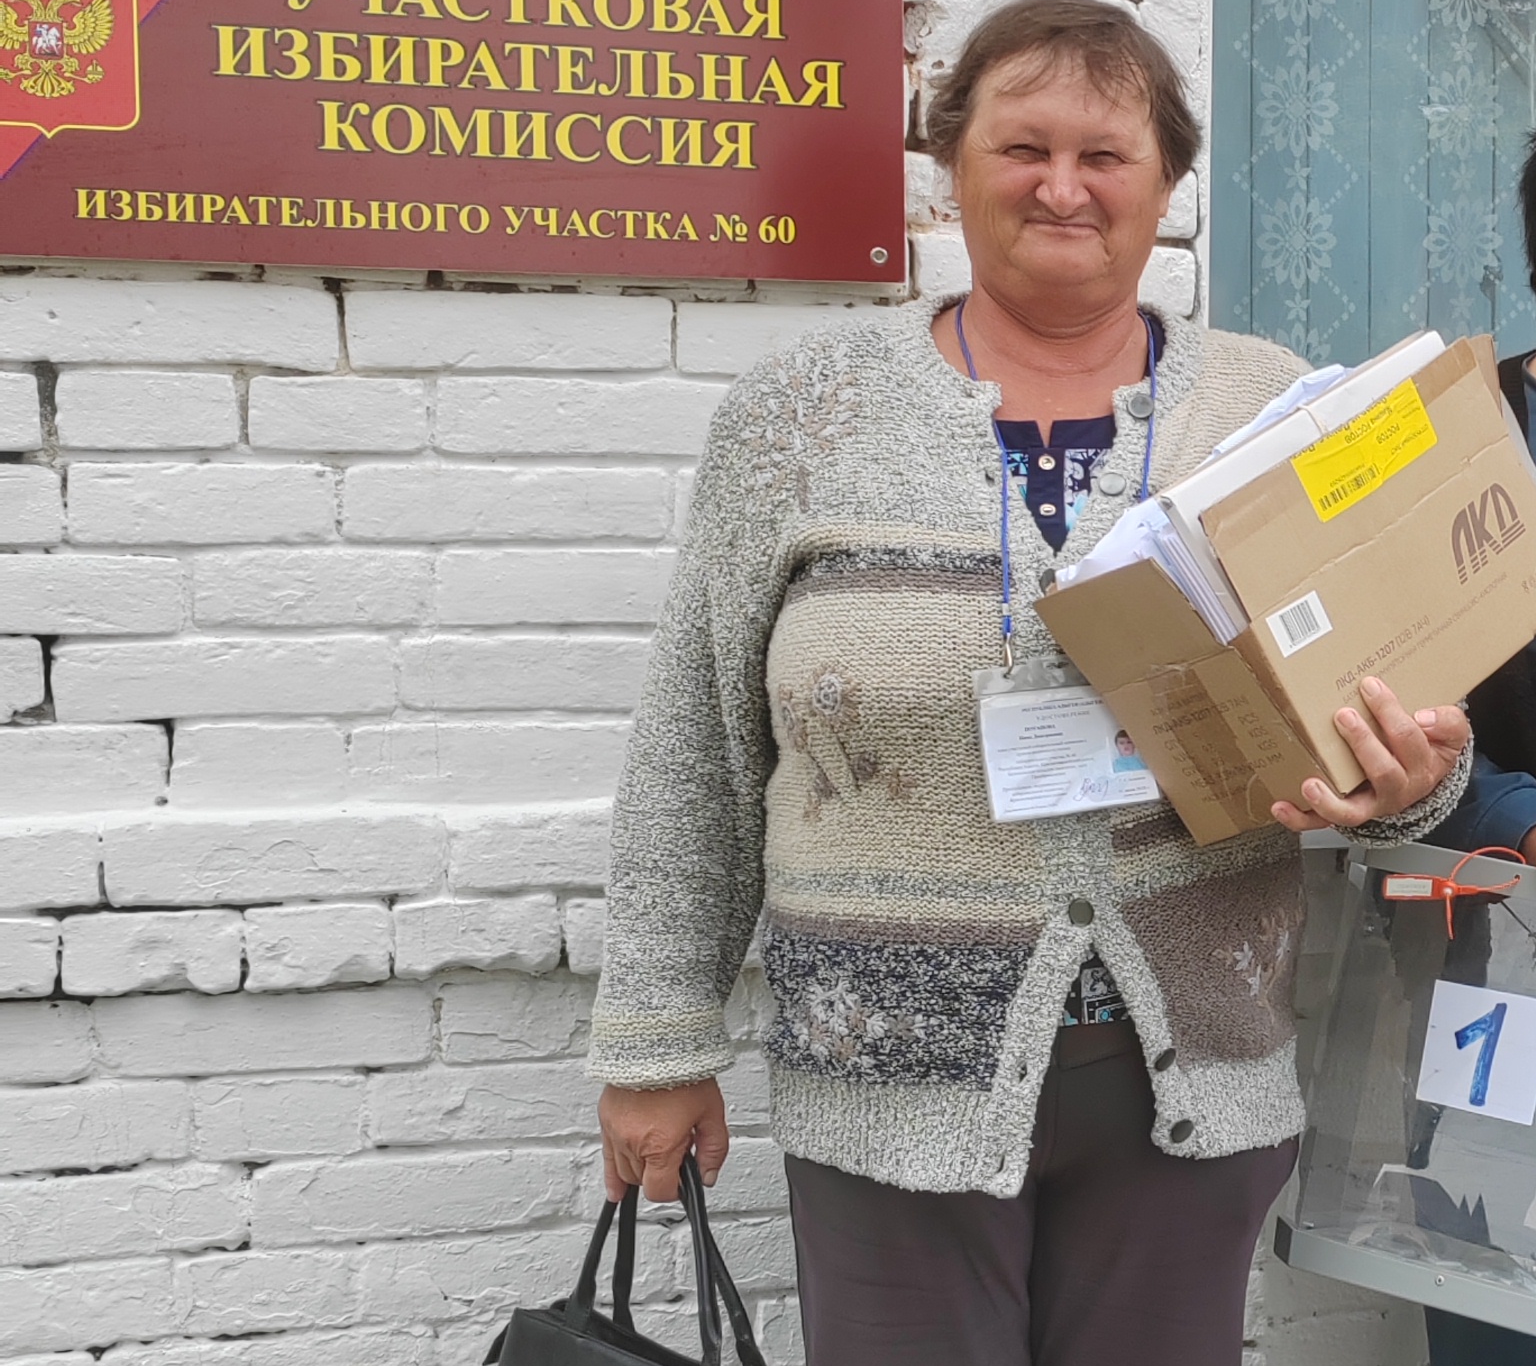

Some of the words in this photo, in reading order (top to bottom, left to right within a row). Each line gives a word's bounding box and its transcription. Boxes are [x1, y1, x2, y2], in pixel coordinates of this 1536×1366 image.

[210, 23, 846, 110] ИЗБИРАТЕЛЬНАЯ
[316, 99, 759, 171] КОМИССИЯ
[74, 187, 491, 235] ИЗБИРАТЕЛЬНОГО
[500, 204, 700, 243] УЧАСТКА
[709, 213, 751, 245] №
[757, 215, 797, 246] 60
[1335, 639, 1396, 691] ЛКД-АКБ-1207
[1454, 1002, 1508, 1107] 1
